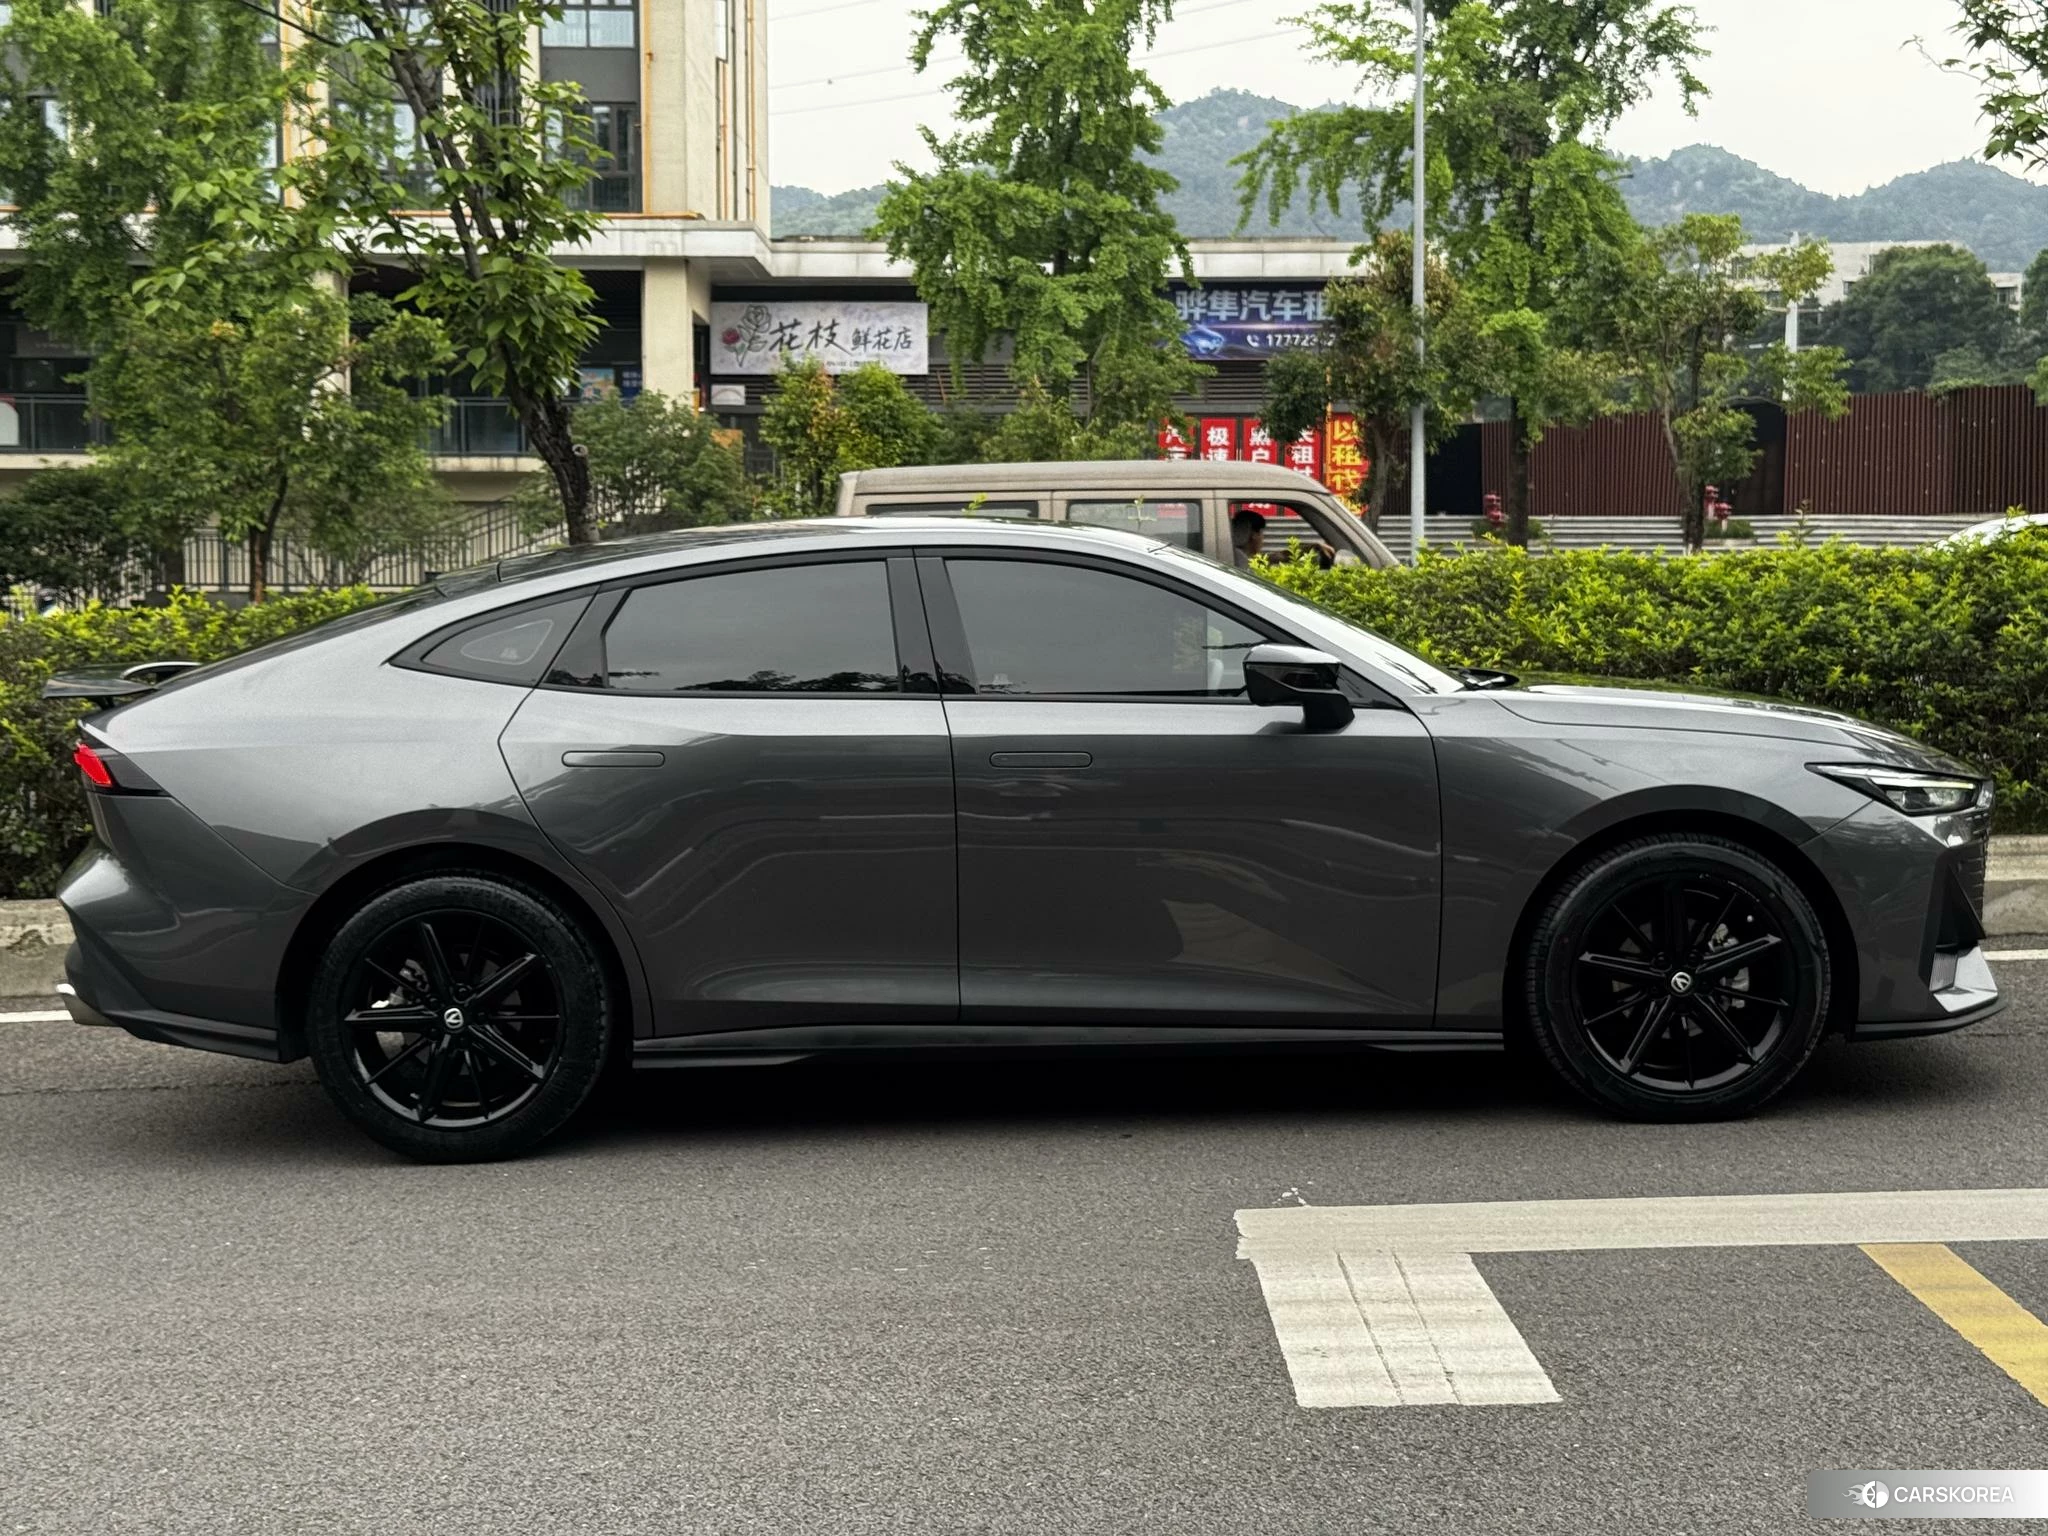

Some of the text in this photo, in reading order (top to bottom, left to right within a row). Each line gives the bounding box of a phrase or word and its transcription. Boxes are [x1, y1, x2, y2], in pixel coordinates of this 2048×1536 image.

[769, 318, 914, 356] 花枝 鲜花店
